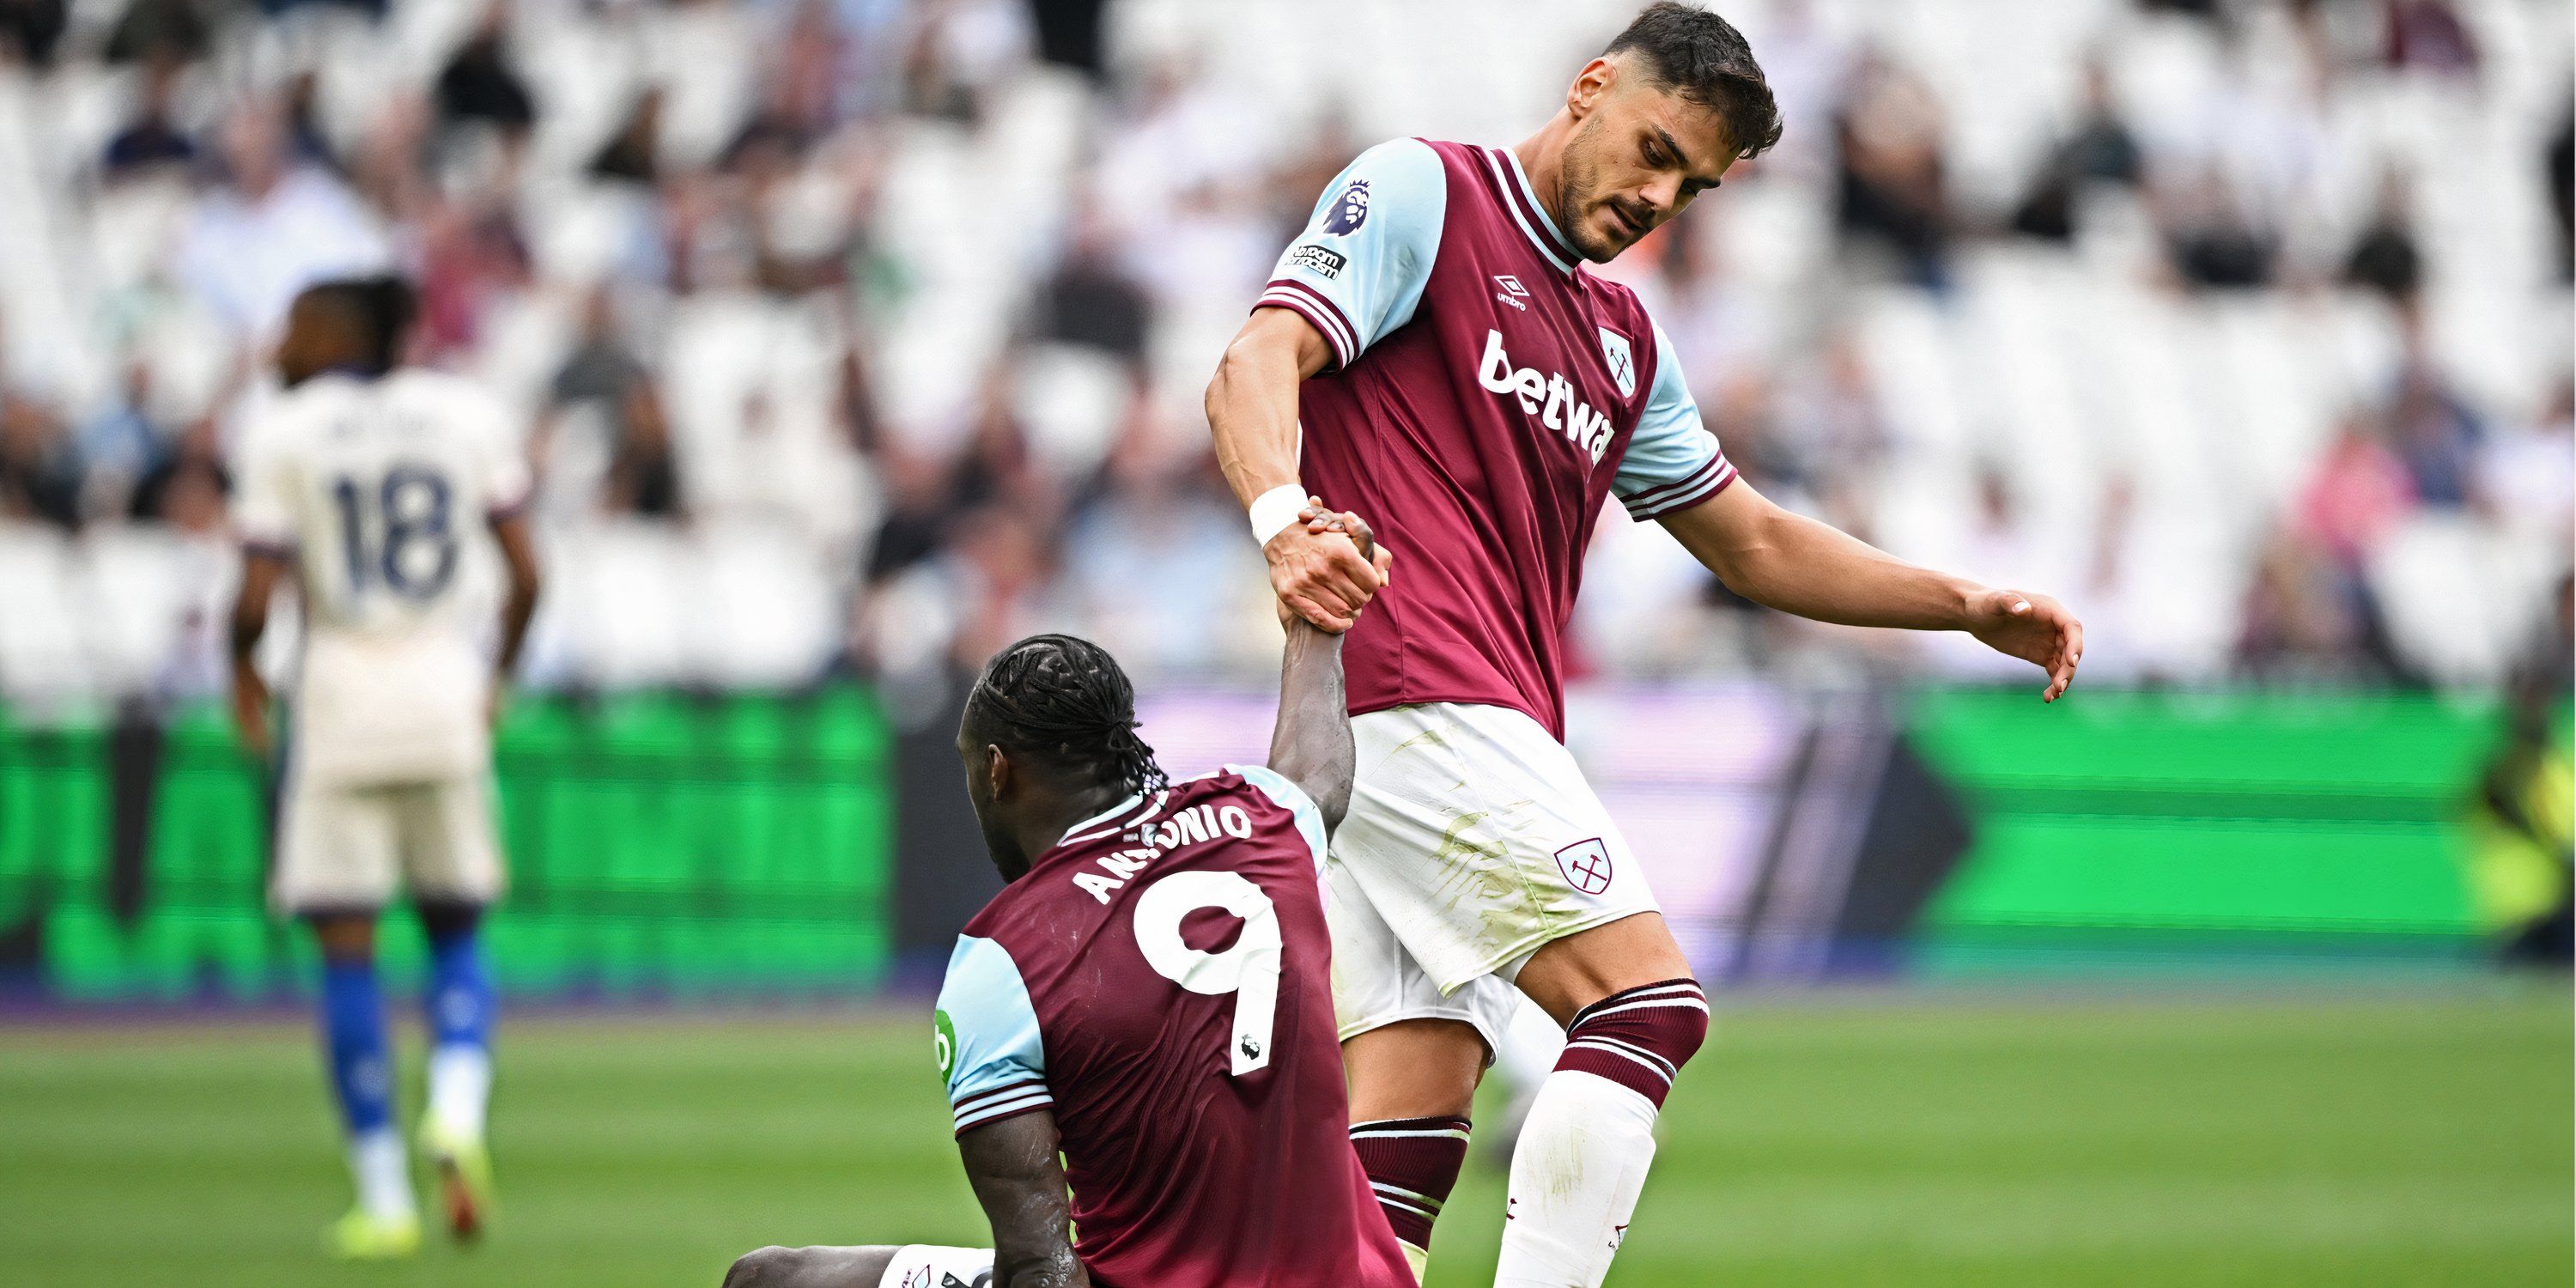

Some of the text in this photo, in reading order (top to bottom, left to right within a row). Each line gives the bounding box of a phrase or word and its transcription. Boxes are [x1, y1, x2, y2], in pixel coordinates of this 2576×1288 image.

[1304, 246, 1340, 268] room
[1497, 292, 1526, 311] umbro
[1479, 328, 1615, 470] betwa
[333, 464, 459, 601] 18
[1133, 870, 1283, 1077] 9
